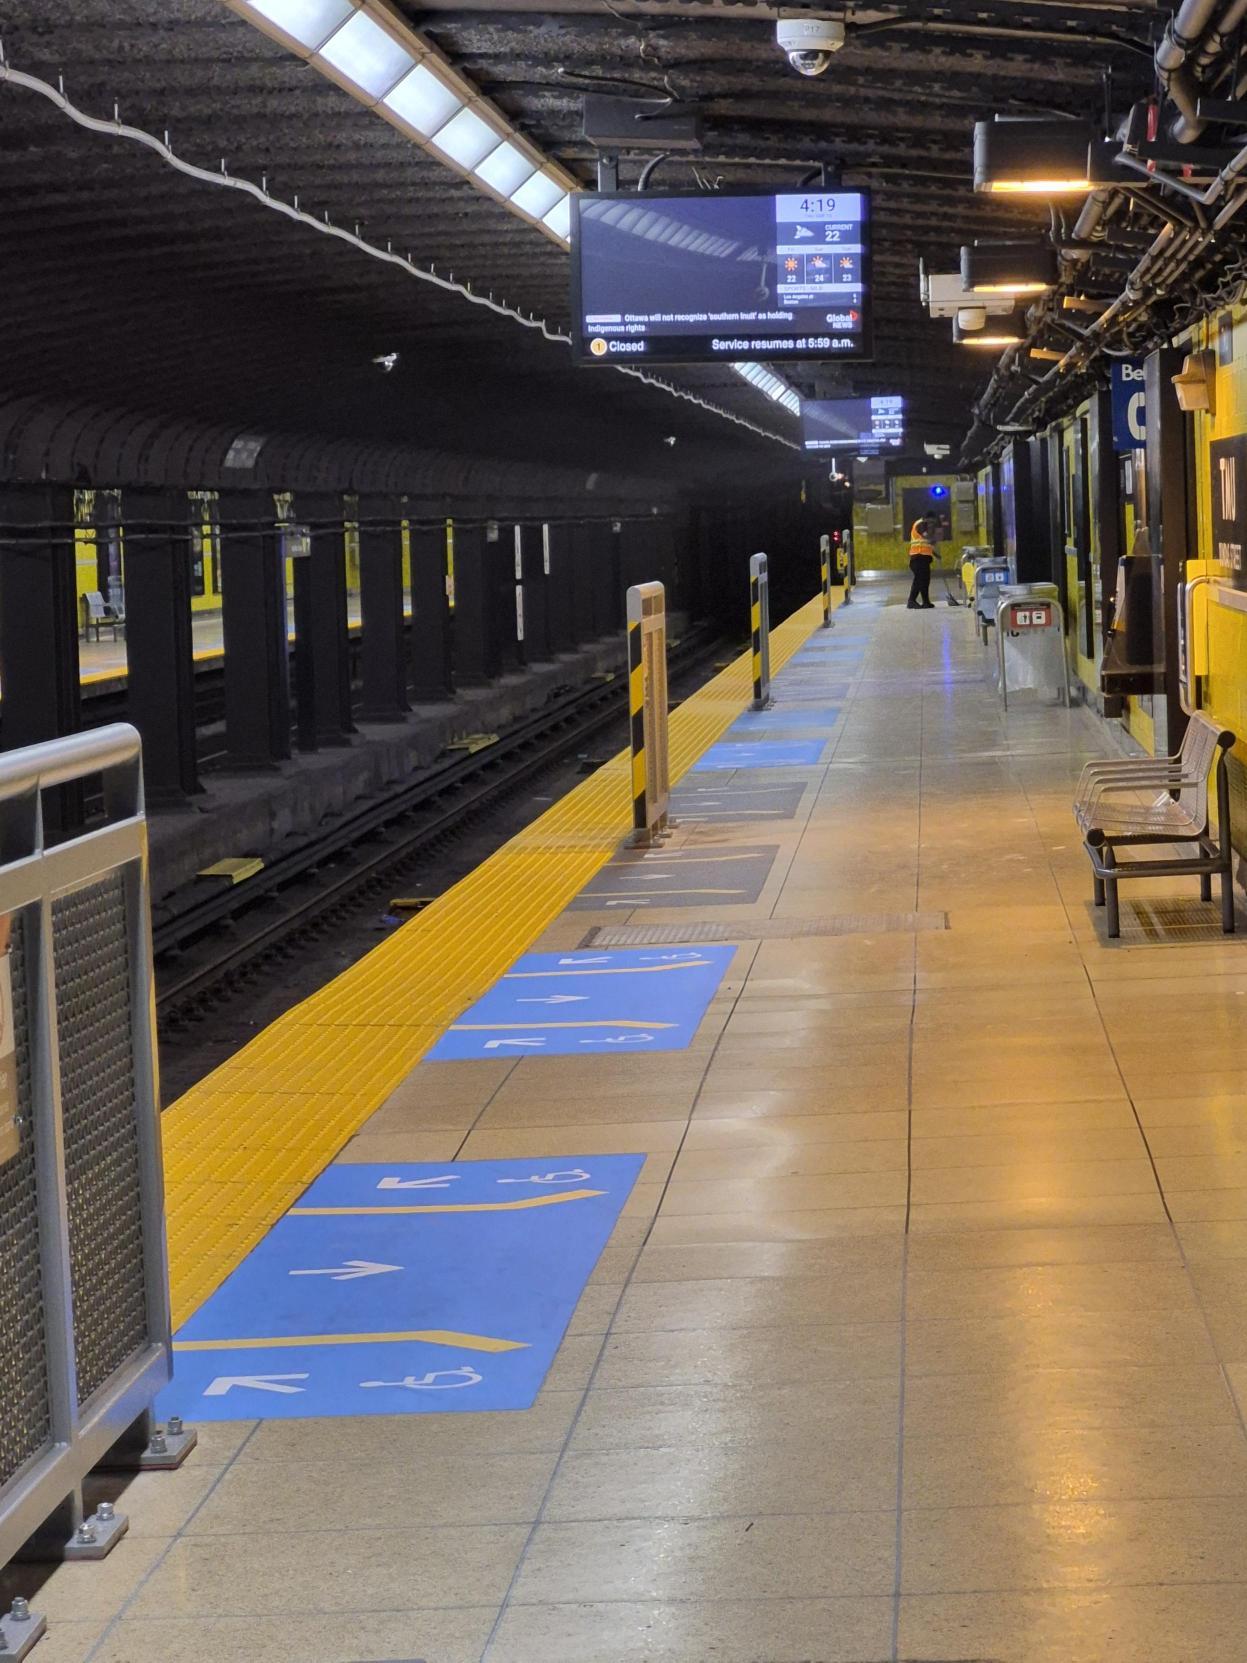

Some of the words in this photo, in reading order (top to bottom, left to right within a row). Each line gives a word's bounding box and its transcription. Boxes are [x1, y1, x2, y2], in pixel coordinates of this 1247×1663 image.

[800, 198, 836, 213] 4:19
[825, 231, 840, 241] 22
[787, 275, 796, 283] 22
[815, 274, 824, 282] 24
[624, 313, 648, 322] Ottawa
[649, 313, 661, 321] will
[662, 313, 673, 321] not
[674, 313, 707, 322] recognize
[767, 311, 793, 321] holding
[826, 314, 852, 324] Global
[588, 324, 625, 333] Indigenous
[626, 324, 645, 333] rights
[609, 341, 644, 352] Closed
[712, 339, 749, 350] Service
[751, 339, 794, 349] resumes
[796, 339, 806, 348] at
[832, 338, 854, 348] a.m.
